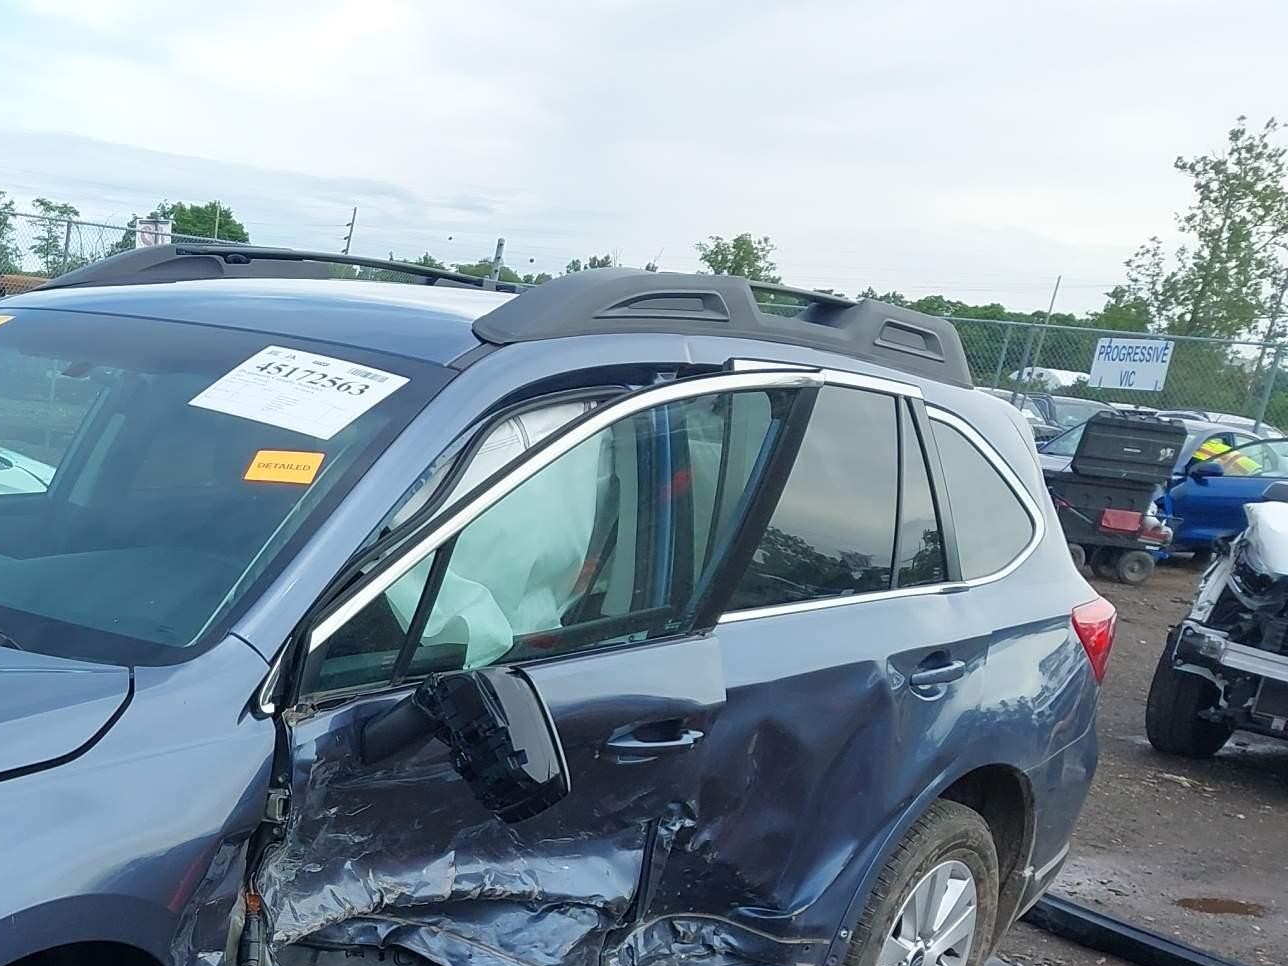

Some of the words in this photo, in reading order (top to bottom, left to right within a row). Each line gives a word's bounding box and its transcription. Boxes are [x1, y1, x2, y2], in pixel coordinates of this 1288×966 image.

[1097, 345, 1170, 363] PROGRESSIVE
[255, 361, 371, 396] 45172563
[1119, 370, 1136, 387] VIC
[257, 462, 311, 471] DETAILED
